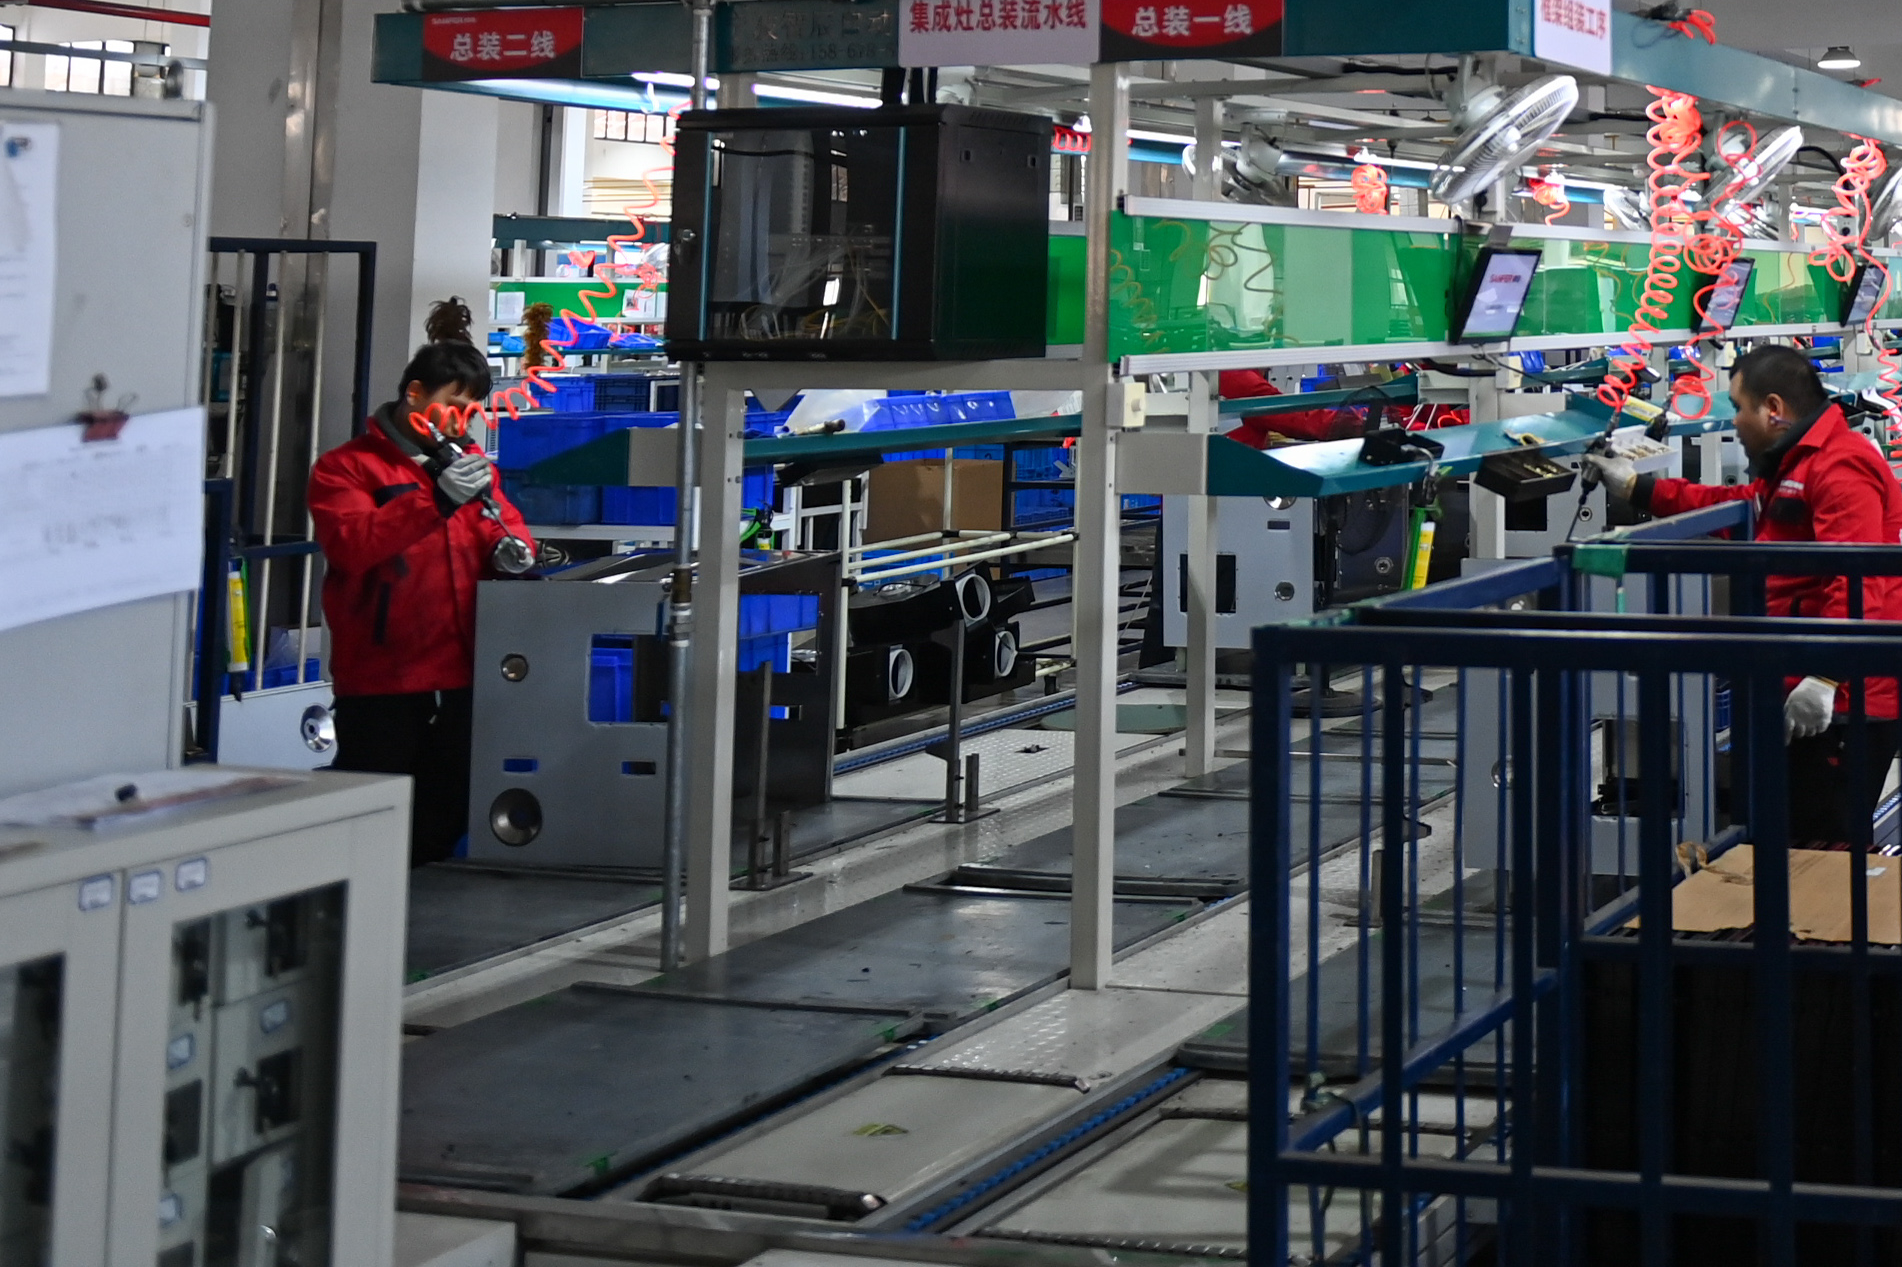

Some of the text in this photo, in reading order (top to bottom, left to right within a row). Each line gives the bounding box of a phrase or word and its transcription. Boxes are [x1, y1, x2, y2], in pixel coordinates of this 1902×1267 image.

[1132, 4, 1253, 36] 总装一线
[450, 30, 555, 61] 总装二线
